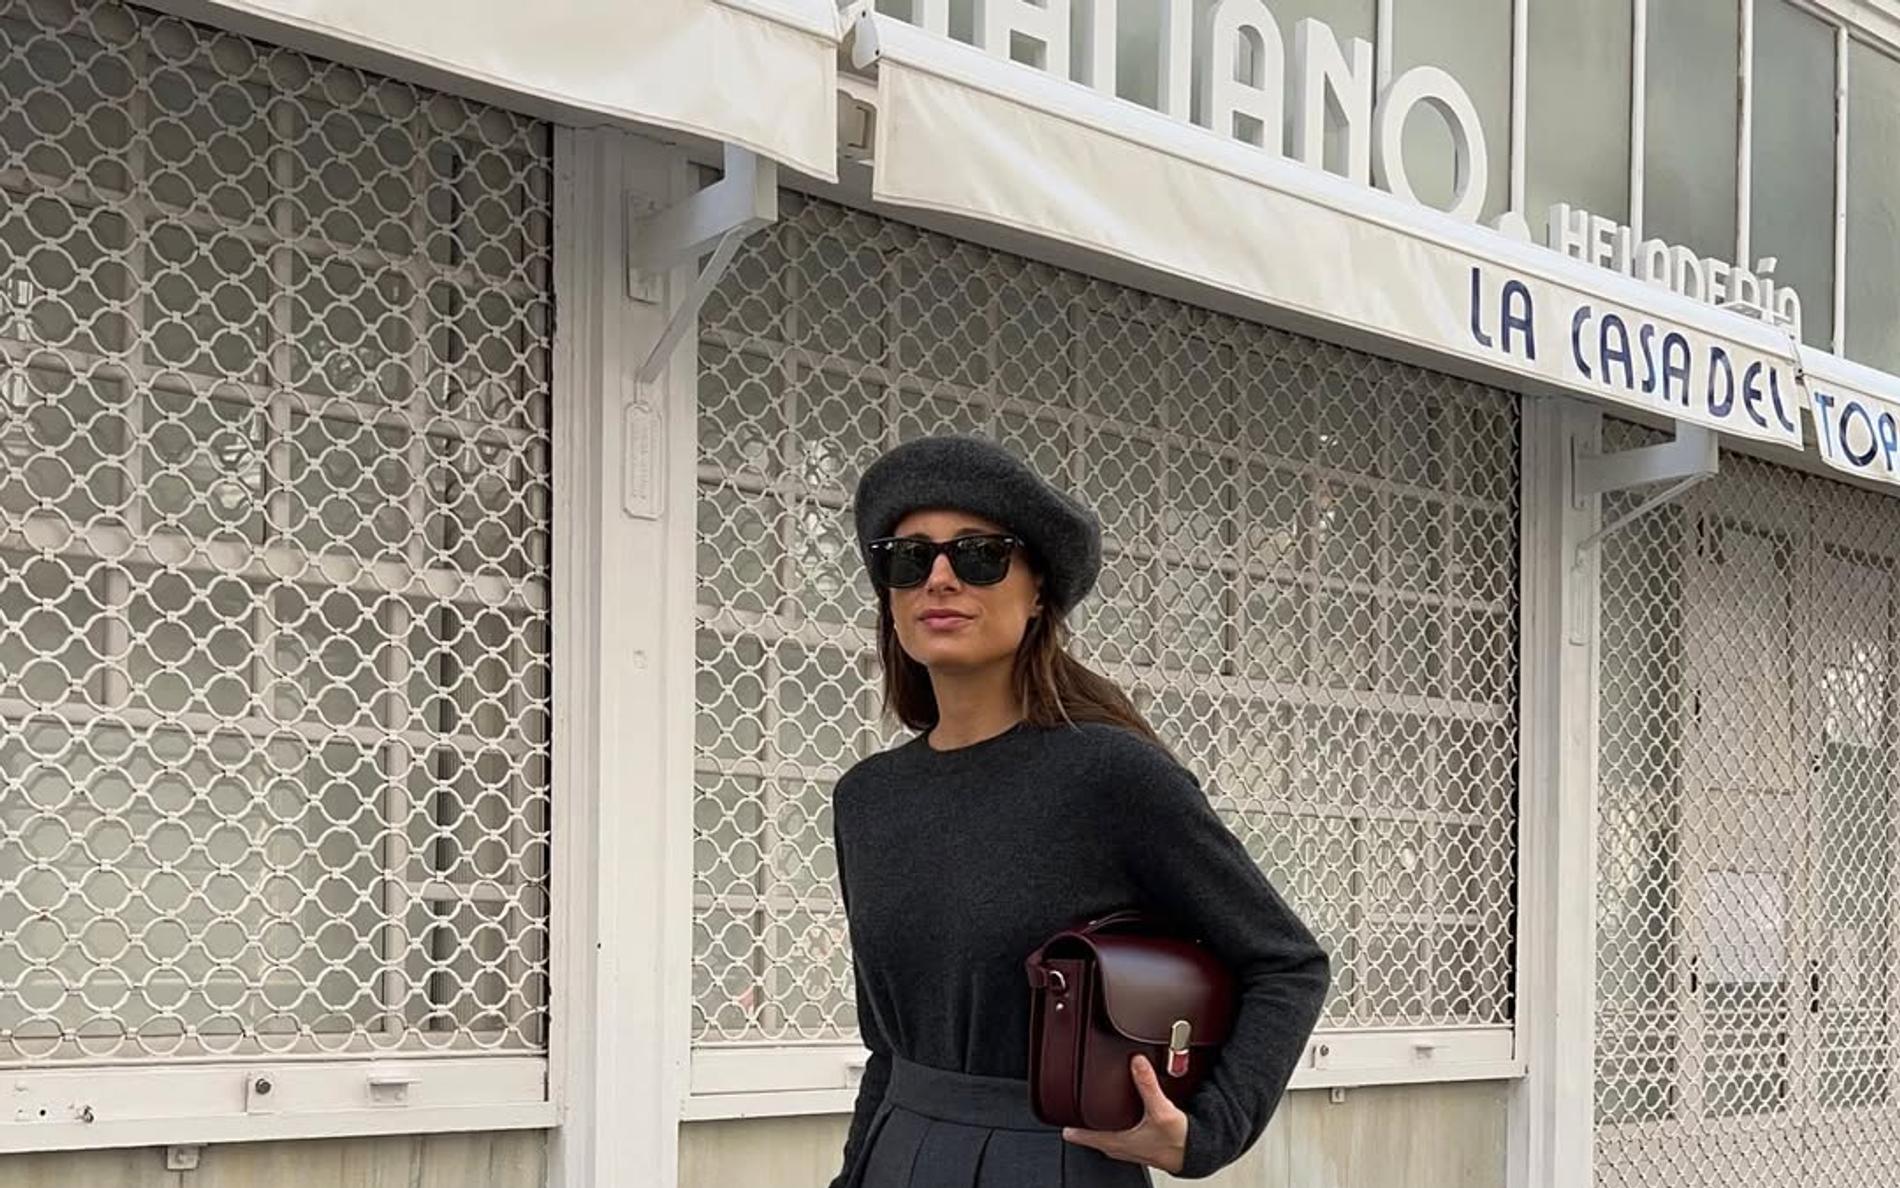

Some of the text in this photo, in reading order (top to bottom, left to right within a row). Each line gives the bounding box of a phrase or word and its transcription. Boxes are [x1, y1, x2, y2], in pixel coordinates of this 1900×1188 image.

[1469, 266, 1536, 361] LA
[1571, 305, 1692, 407] CASA
[1708, 346, 1795, 433] DEL
